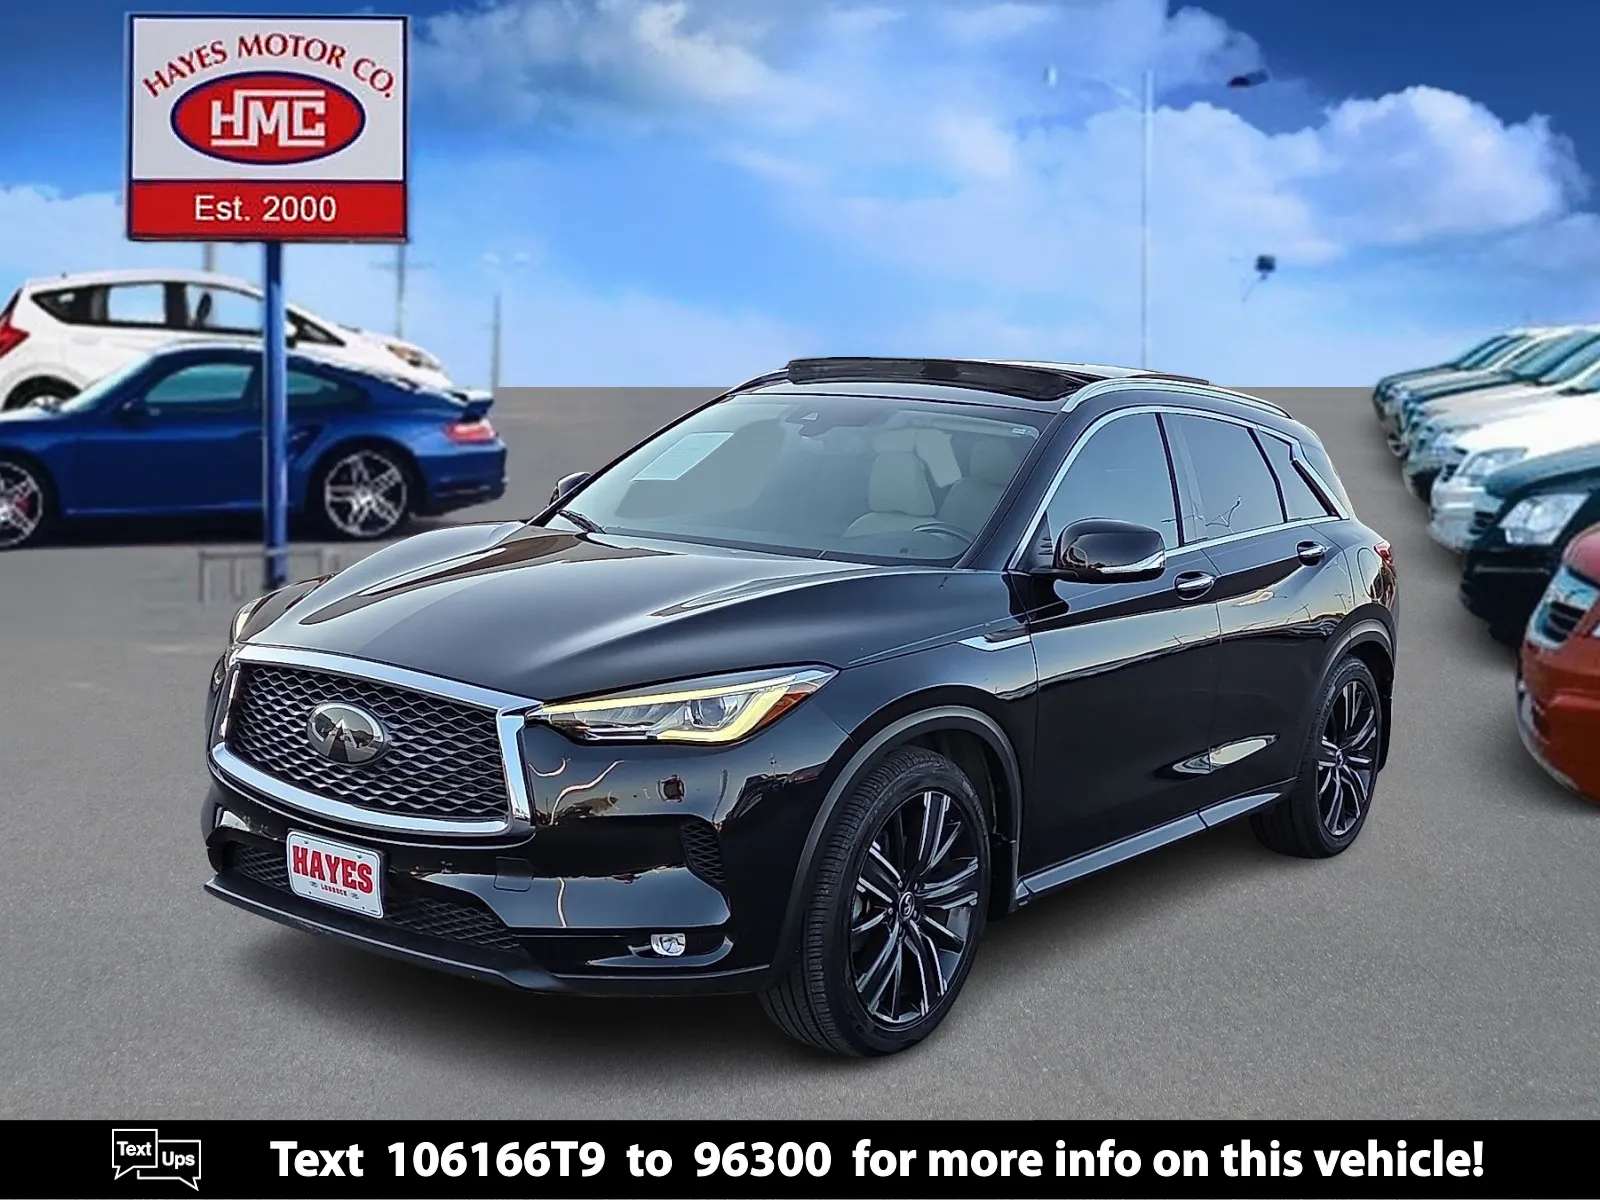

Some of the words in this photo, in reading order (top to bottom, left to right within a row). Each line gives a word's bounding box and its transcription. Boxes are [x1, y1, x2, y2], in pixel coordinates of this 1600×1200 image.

[142, 40, 228, 98] HAYES
[237, 32, 348, 70] MOTOR
[351, 57, 396, 99] CO.
[210, 89, 326, 148] HMC
[194, 194, 251, 222] Est.
[262, 194, 337, 222] 2000
[292, 845, 373, 894] HAYES
